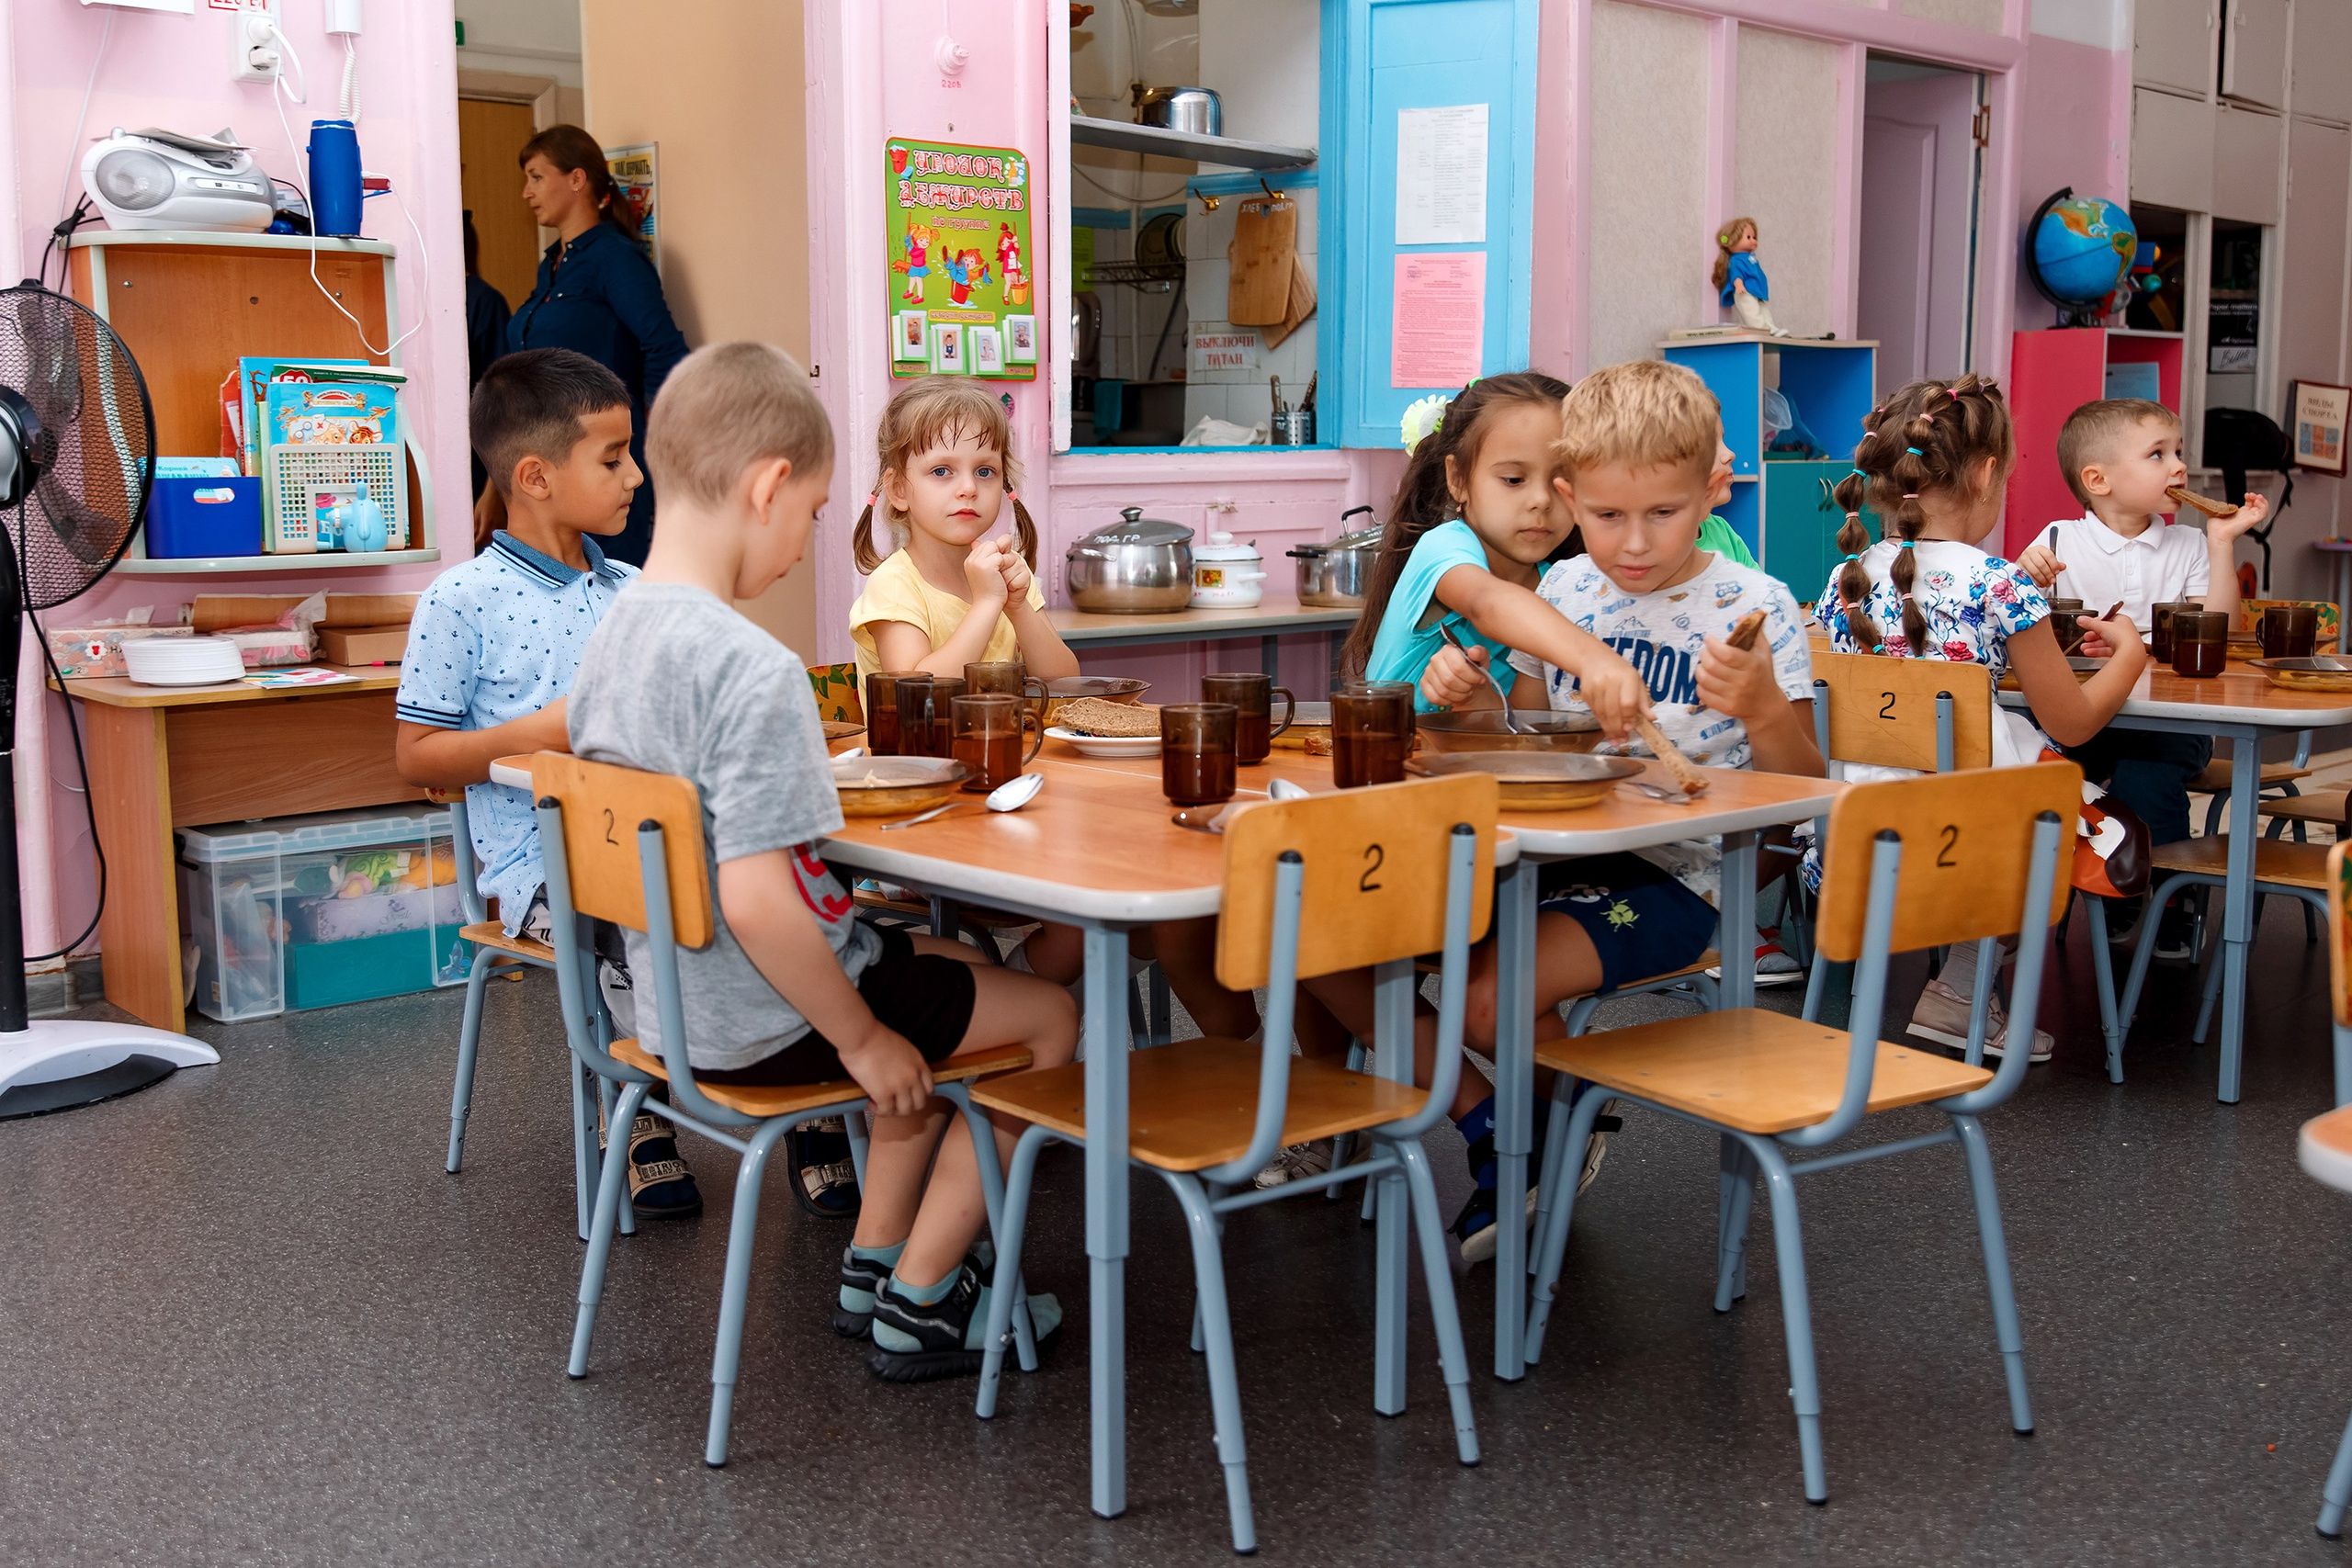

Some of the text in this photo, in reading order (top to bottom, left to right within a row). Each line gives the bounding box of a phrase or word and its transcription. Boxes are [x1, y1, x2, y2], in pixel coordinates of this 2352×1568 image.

[899, 180, 1024, 210] ДЕЖУРСТВ
[932, 216, 990, 231] по группе
[1195, 334, 1255, 348] ВЫКЛЮЧИ
[1206, 353, 1243, 366] ТИТАН
[1879, 692, 1896, 720] 2
[604, 807, 619, 846] 2
[1937, 825, 1959, 867] 2
[1360, 843, 1384, 892] 2
